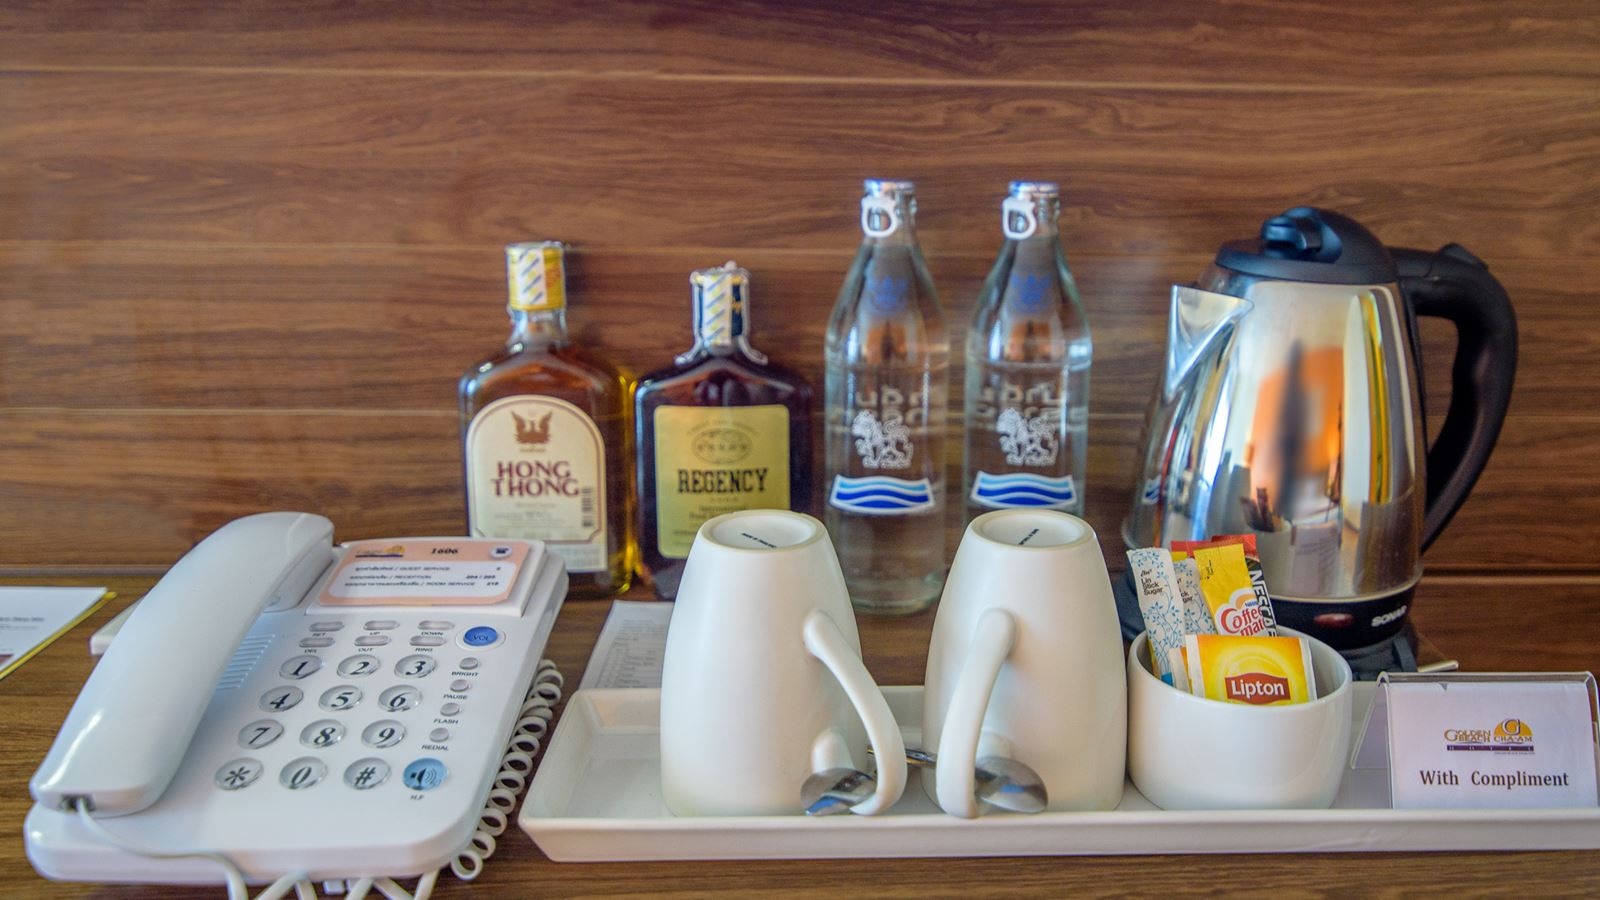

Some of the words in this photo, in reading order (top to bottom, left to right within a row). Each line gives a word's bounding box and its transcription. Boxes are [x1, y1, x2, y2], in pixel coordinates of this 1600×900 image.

[497, 461, 571, 478] HONG
[491, 478, 580, 497] THONG
[677, 468, 768, 493] REGENCY
[1144, 587, 1162, 596] Sugar
[292, 660, 309, 676] 1
[349, 661, 370, 675] 2
[405, 660, 426, 675] 3
[1231, 679, 1285, 698] Lipton
[269, 691, 288, 709] 4
[331, 690, 353, 708] 5
[390, 691, 407, 708] 6
[248, 727, 269, 744] 7
[313, 726, 334, 745] 8
[378, 727, 396, 743] 9
[1444, 729, 1491, 742] GOLDEN
[1458, 735, 1491, 743] BEACH
[291, 766, 311, 785] 0
[1420, 770, 1459, 785] With
[1471, 771, 1569, 790] Compliment
